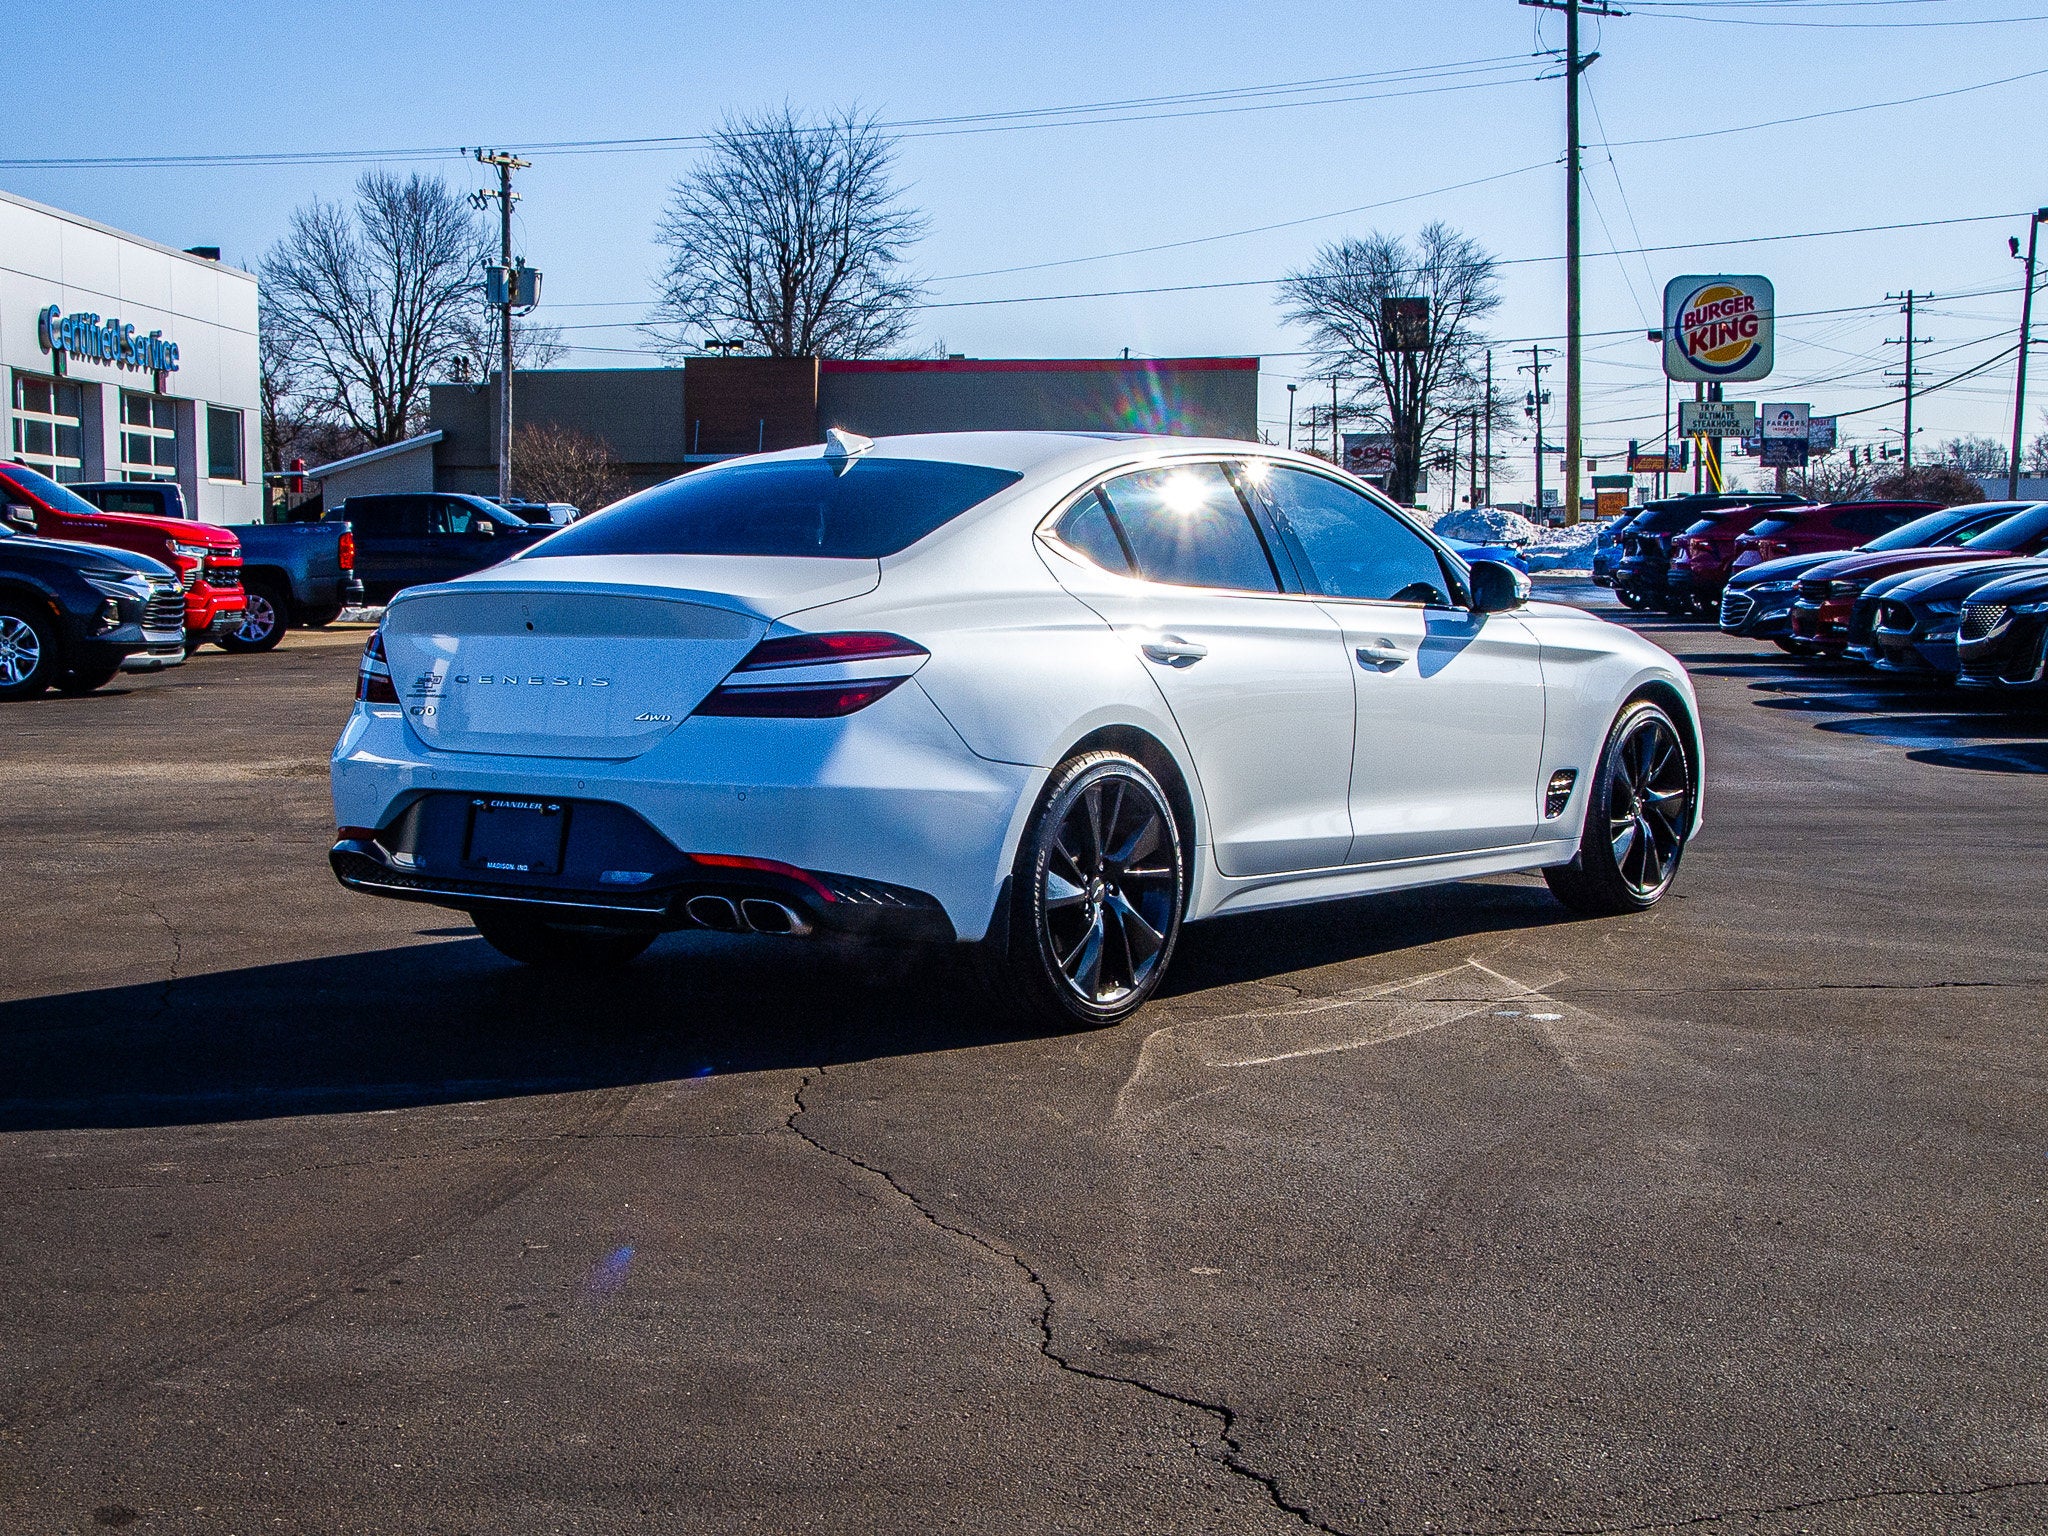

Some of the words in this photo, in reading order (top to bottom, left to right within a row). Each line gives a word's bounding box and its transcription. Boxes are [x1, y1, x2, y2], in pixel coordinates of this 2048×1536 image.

[1684, 295, 1755, 331] BURGER
[44, 304, 120, 361] Certified
[123, 323, 179, 372] Service
[1688, 314, 1759, 357] KING
[1687, 428, 1722, 436] WHOPPER
[454, 674, 611, 687] GENESIS
[634, 712, 671, 722] 4WD
[490, 800, 543, 809] CHANDLER
